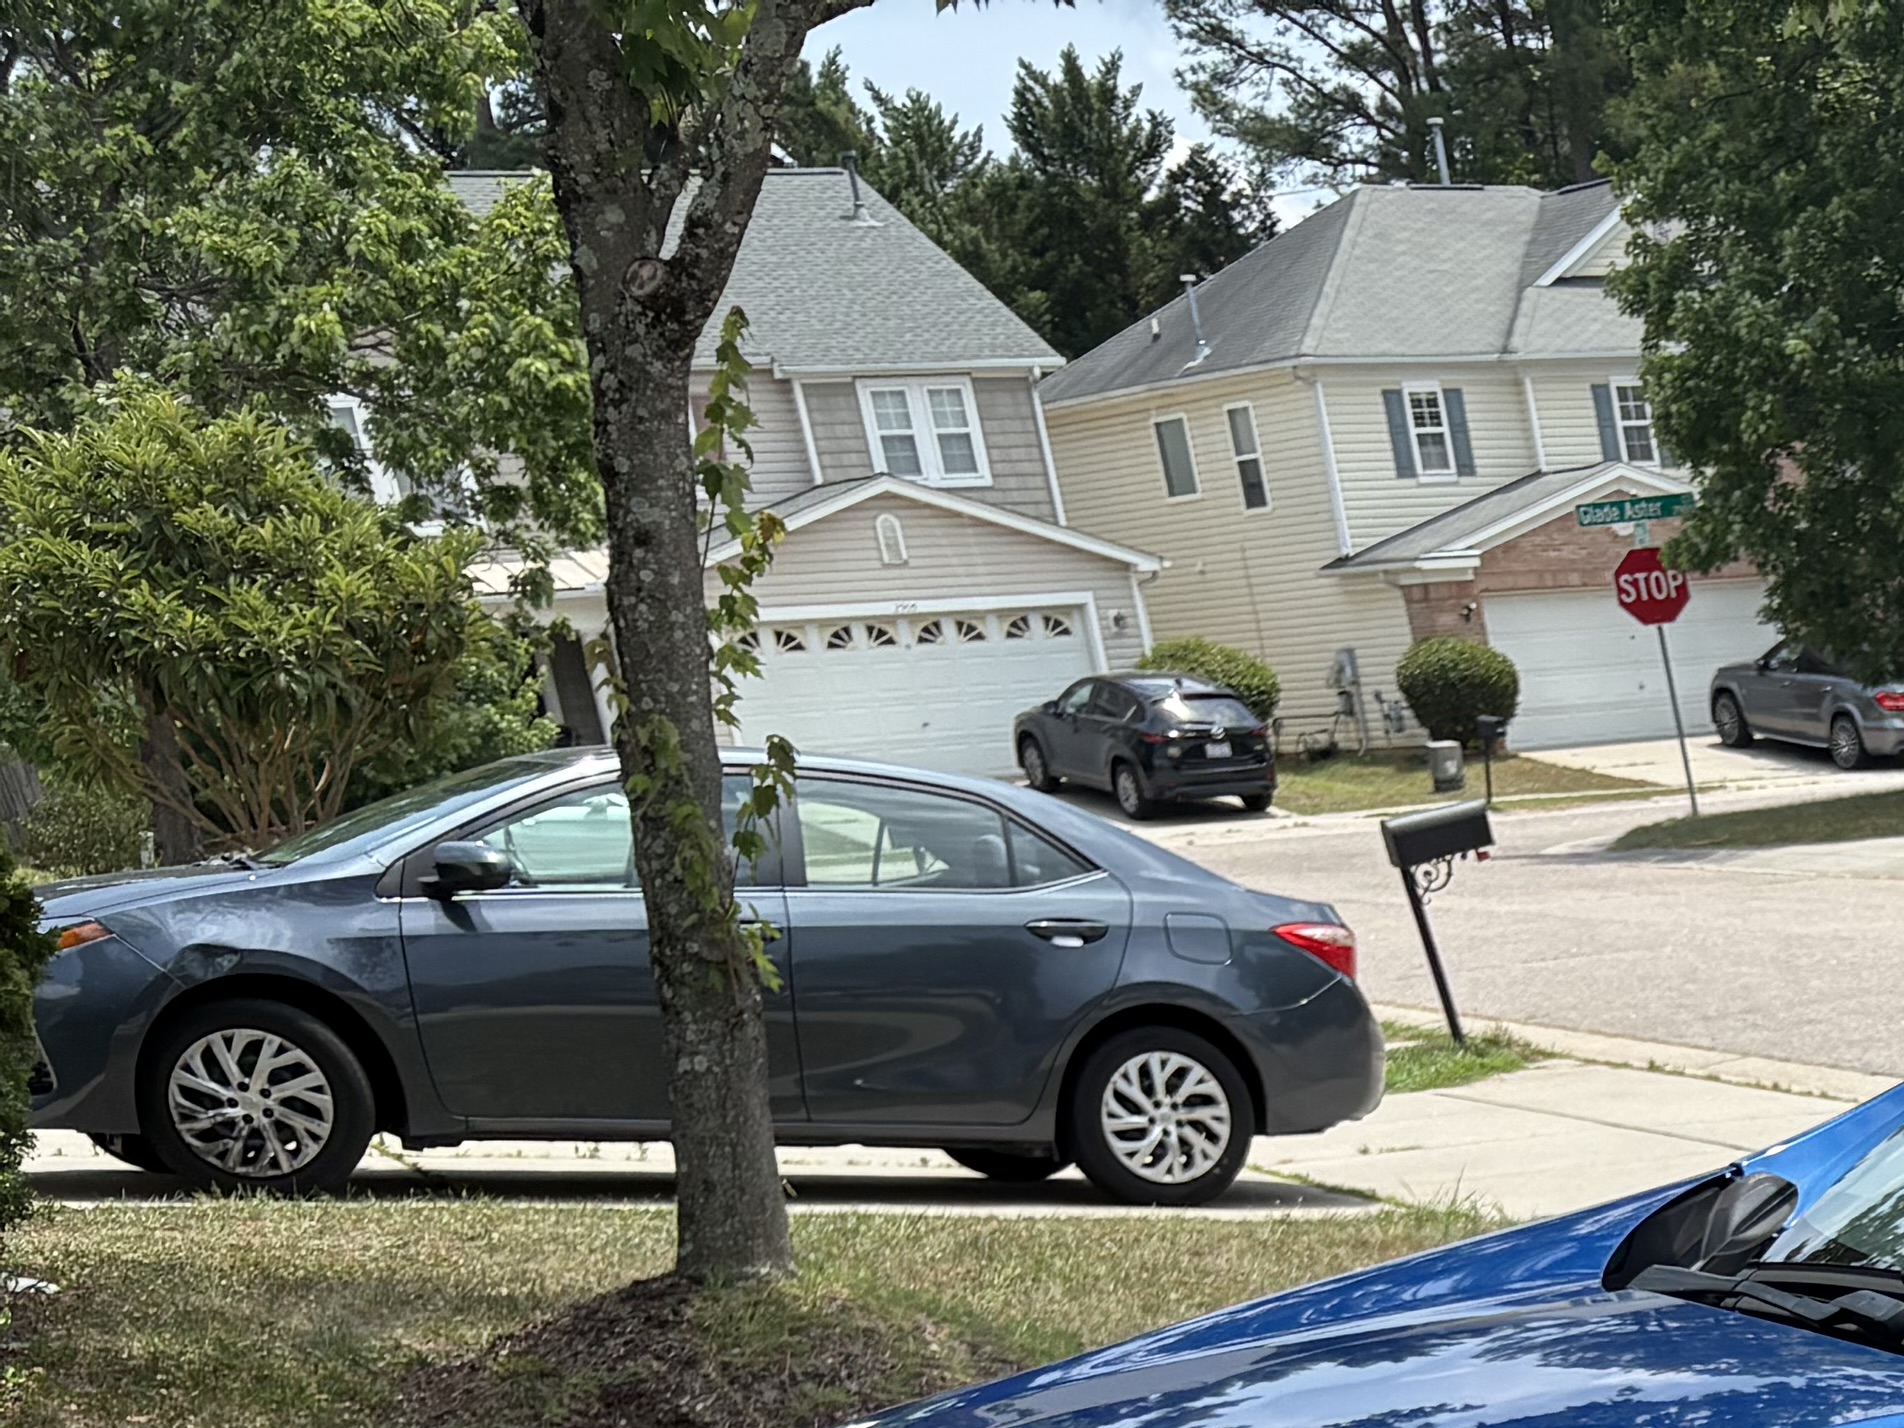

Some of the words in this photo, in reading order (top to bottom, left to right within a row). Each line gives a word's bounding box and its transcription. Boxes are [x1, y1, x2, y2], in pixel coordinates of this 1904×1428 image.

[1579, 504, 1621, 525] Glade
[1623, 499, 1662, 520] Aster
[1618, 570, 1684, 603] STOP
